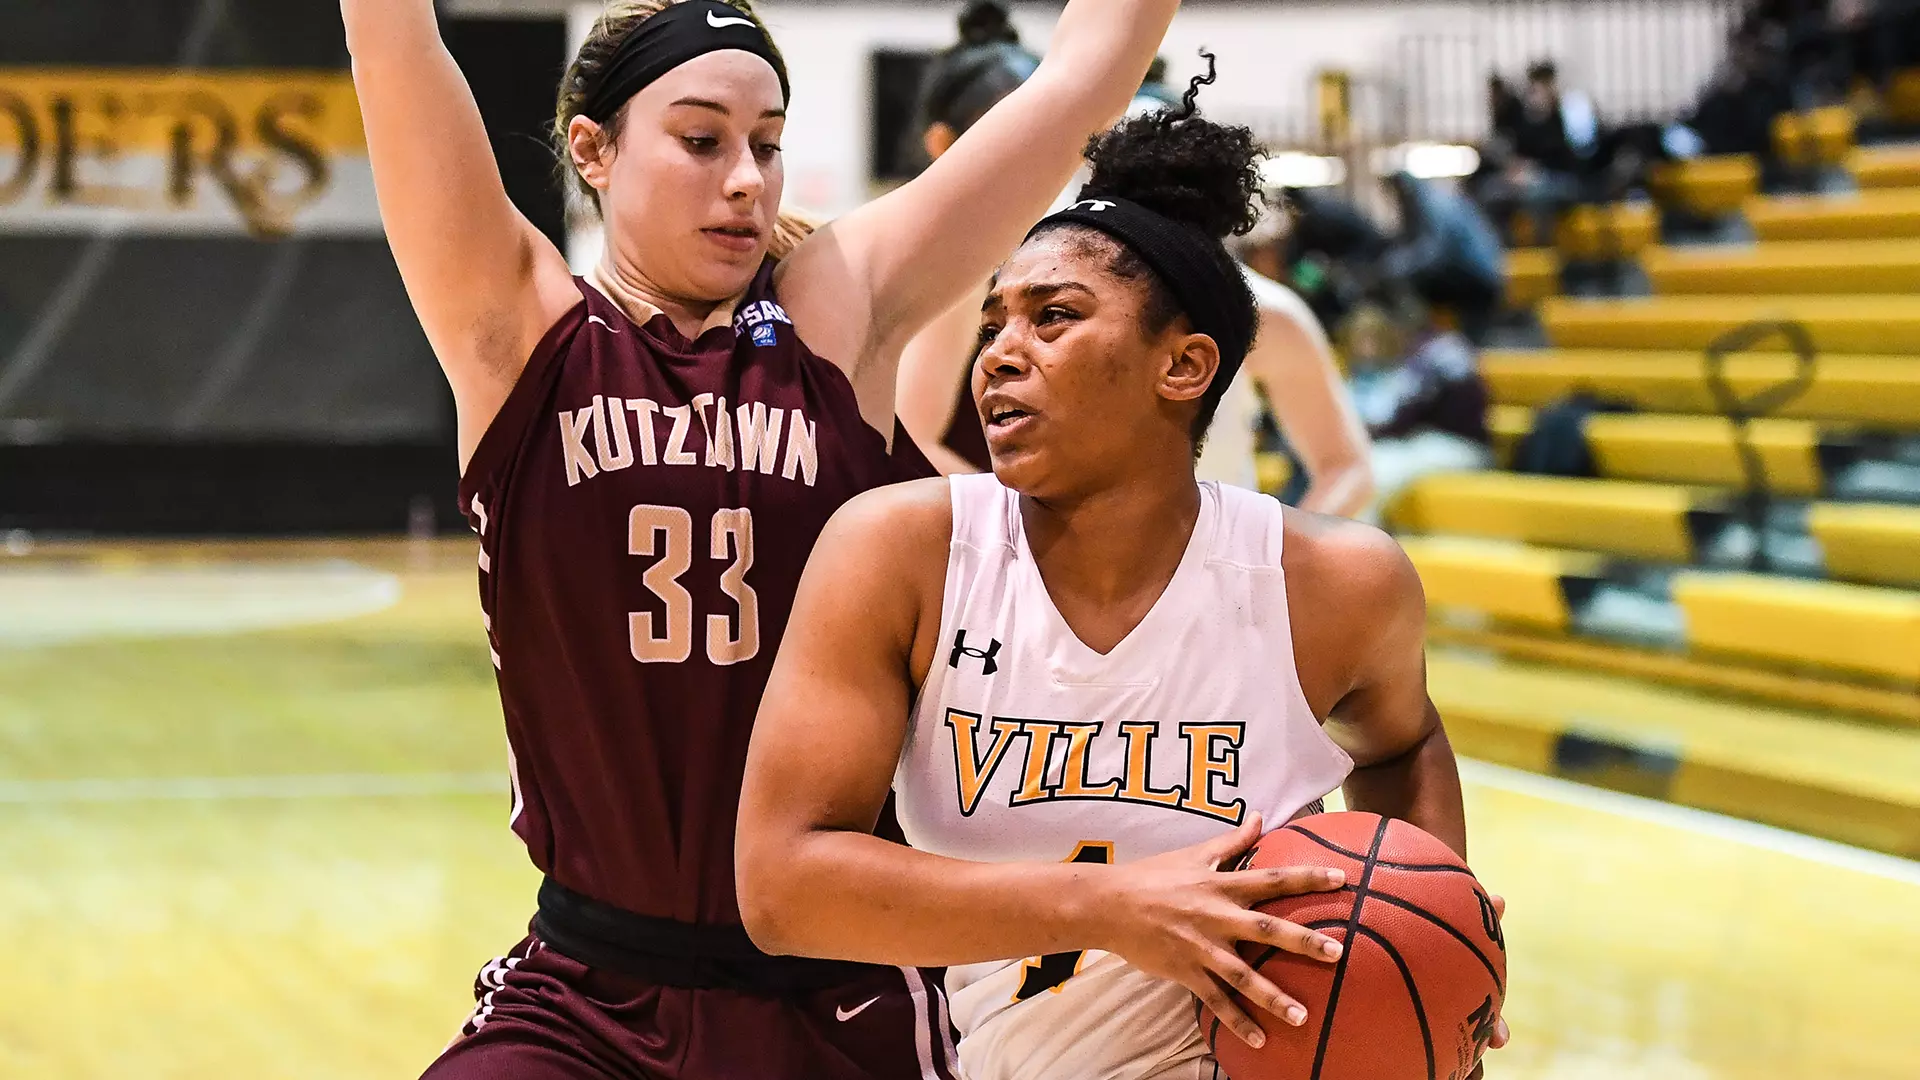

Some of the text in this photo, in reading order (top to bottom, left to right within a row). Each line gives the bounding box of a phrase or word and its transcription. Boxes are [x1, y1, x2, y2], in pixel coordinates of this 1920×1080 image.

[558, 393, 819, 487] KUTZTOWN
[628, 504, 760, 666] 33
[944, 707, 1247, 827] VILLE
